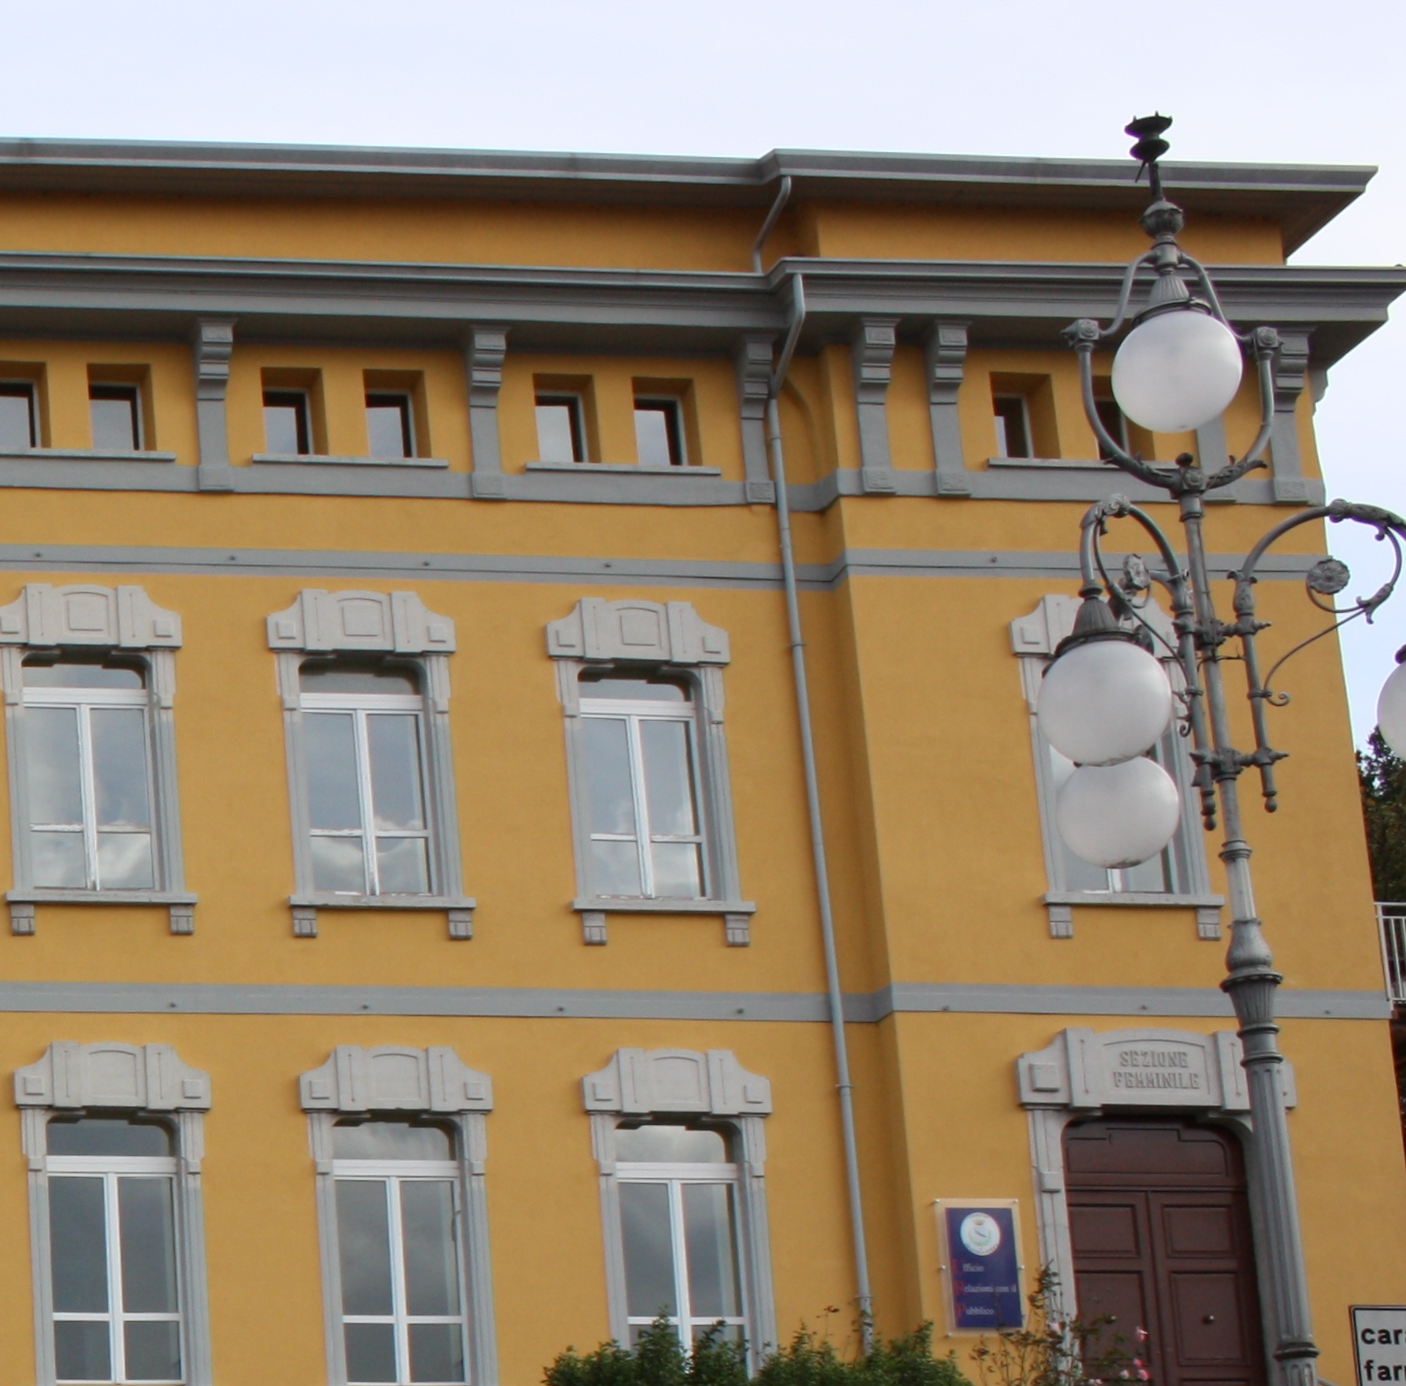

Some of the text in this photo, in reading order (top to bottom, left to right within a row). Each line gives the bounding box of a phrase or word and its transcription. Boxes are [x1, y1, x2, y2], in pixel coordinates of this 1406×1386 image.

[1120, 1050, 1189, 1068] SEZIONE
[1113, 1071, 1200, 1090] FEMMINILE
[1361, 1327, 1406, 1345] car
[1364, 1360, 1406, 1381] far
